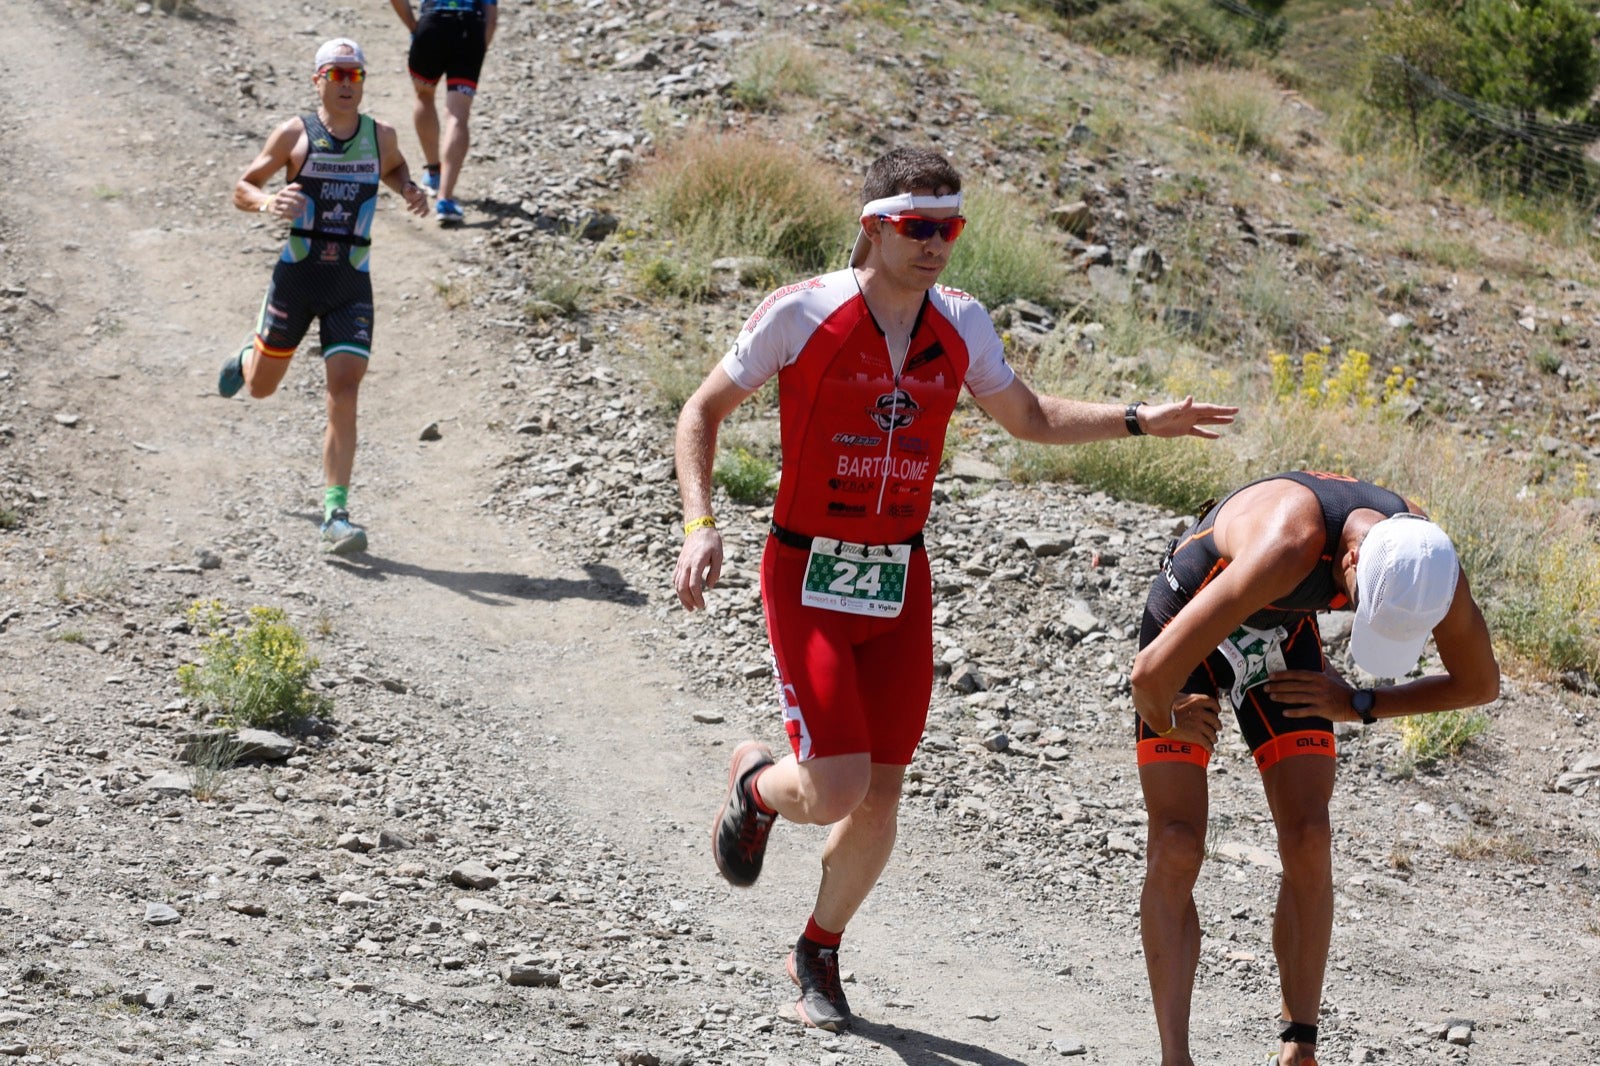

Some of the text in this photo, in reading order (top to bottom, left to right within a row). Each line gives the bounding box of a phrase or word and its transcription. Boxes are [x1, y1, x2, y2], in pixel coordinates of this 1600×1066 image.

[311, 162, 375, 174] TORREMOLINOS
[837, 455, 930, 480] BARTOLOMÉ
[828, 561, 881, 596] 24
